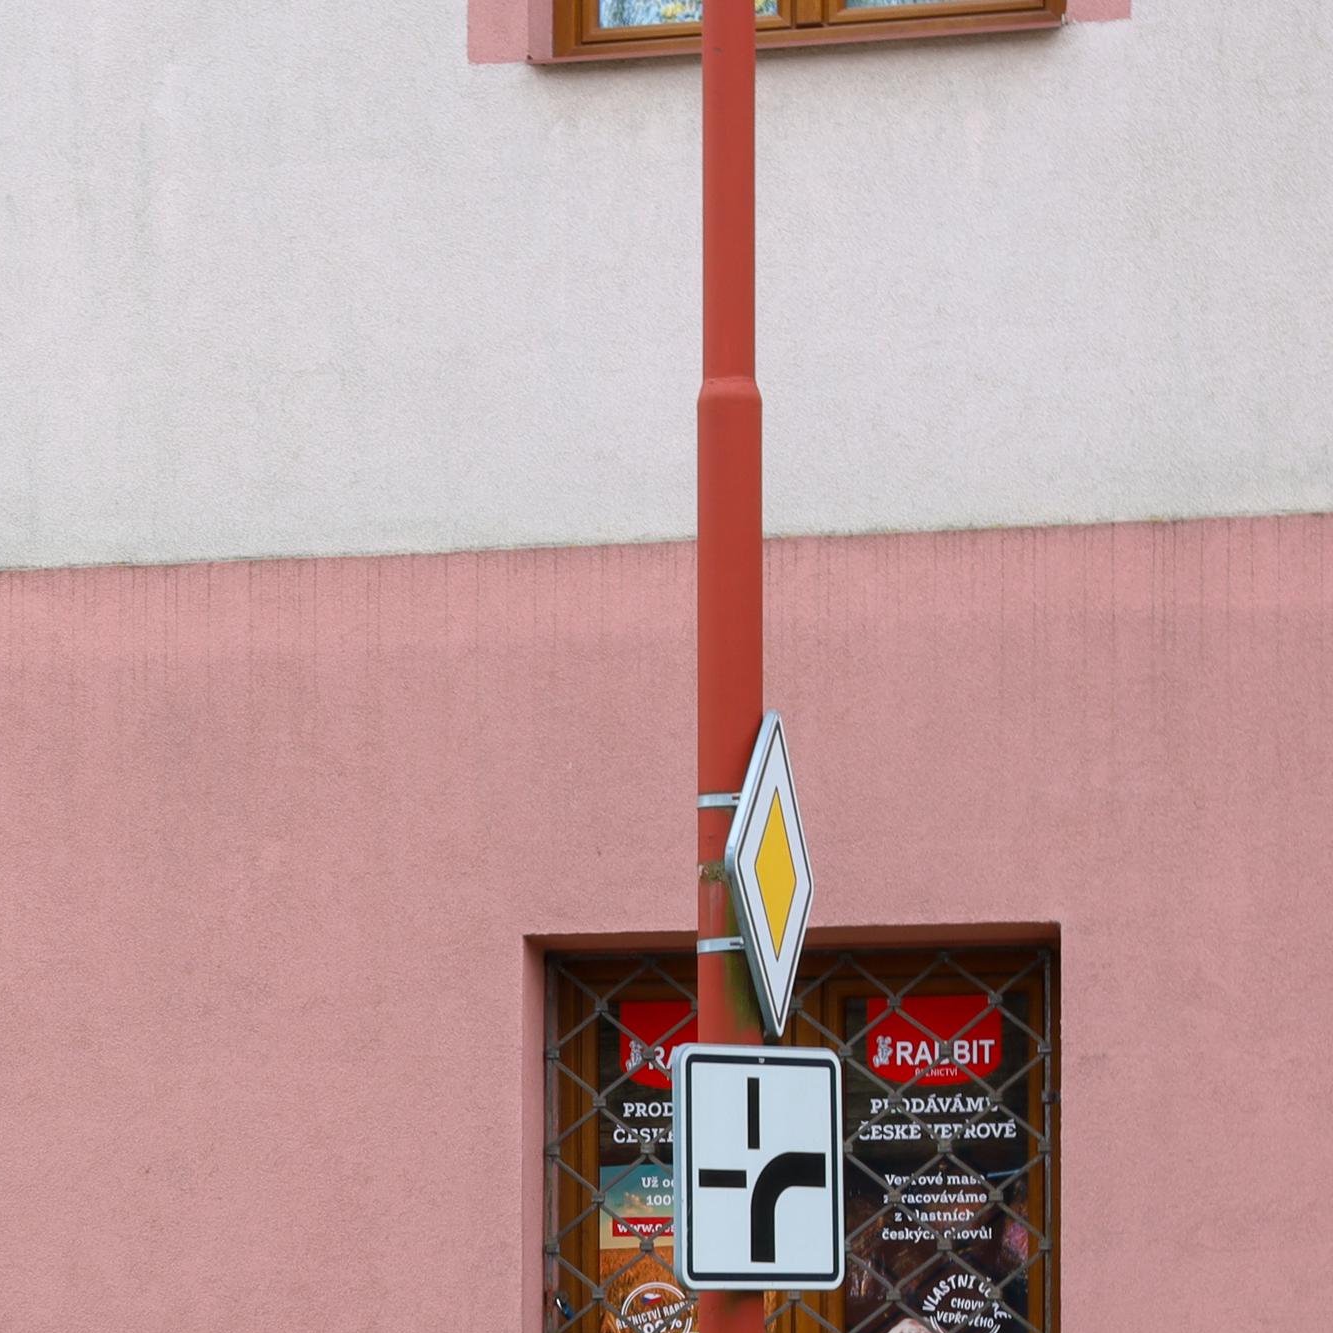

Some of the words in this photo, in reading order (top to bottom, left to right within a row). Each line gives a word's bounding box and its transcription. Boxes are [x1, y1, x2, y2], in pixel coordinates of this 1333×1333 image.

[859, 1120, 921, 1140] ČESKÉ
[641, 1176, 659, 1188] Už
[646, 1195, 674, 1206] 100
[883, 1190, 987, 1204] zracováváme
[894, 1212, 903, 1222] z
